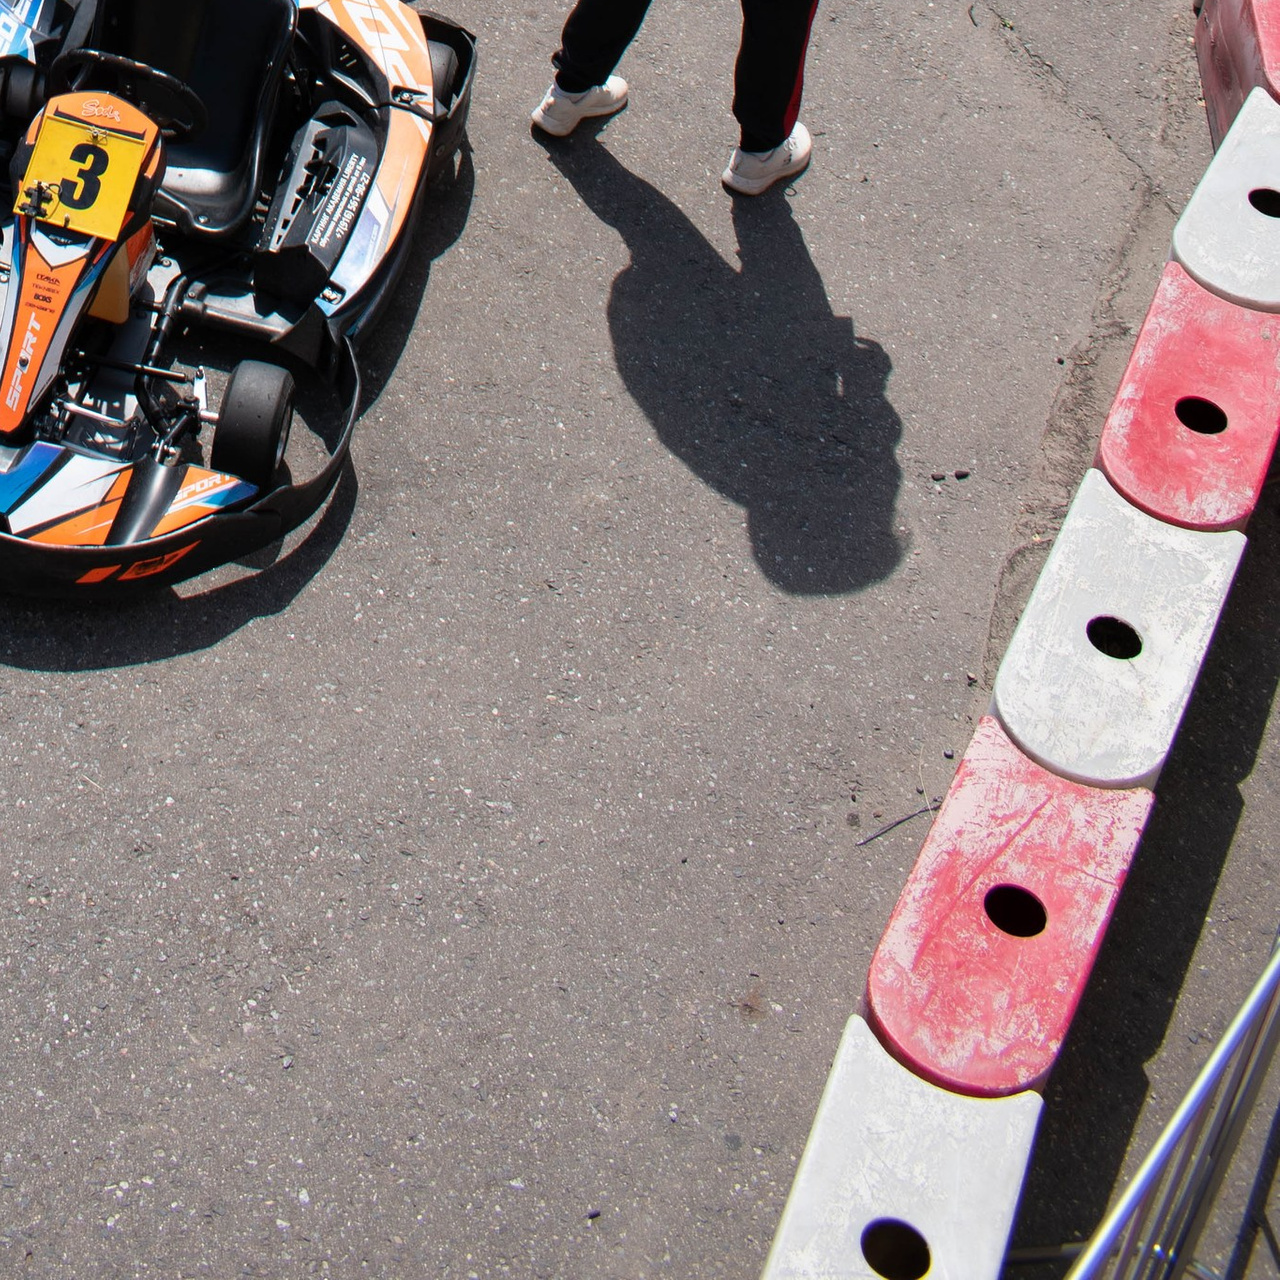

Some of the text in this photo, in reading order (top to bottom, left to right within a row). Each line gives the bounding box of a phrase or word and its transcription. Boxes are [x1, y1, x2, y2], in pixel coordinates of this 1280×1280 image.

[60, 143, 109, 210] 3
[310, 153, 359, 244] КАРТИНГ АКАДЕМИЯ LIBERTY
[334, 172, 372, 240] +7(916) 561-90-27
[5, 312, 41, 412] SPORT
